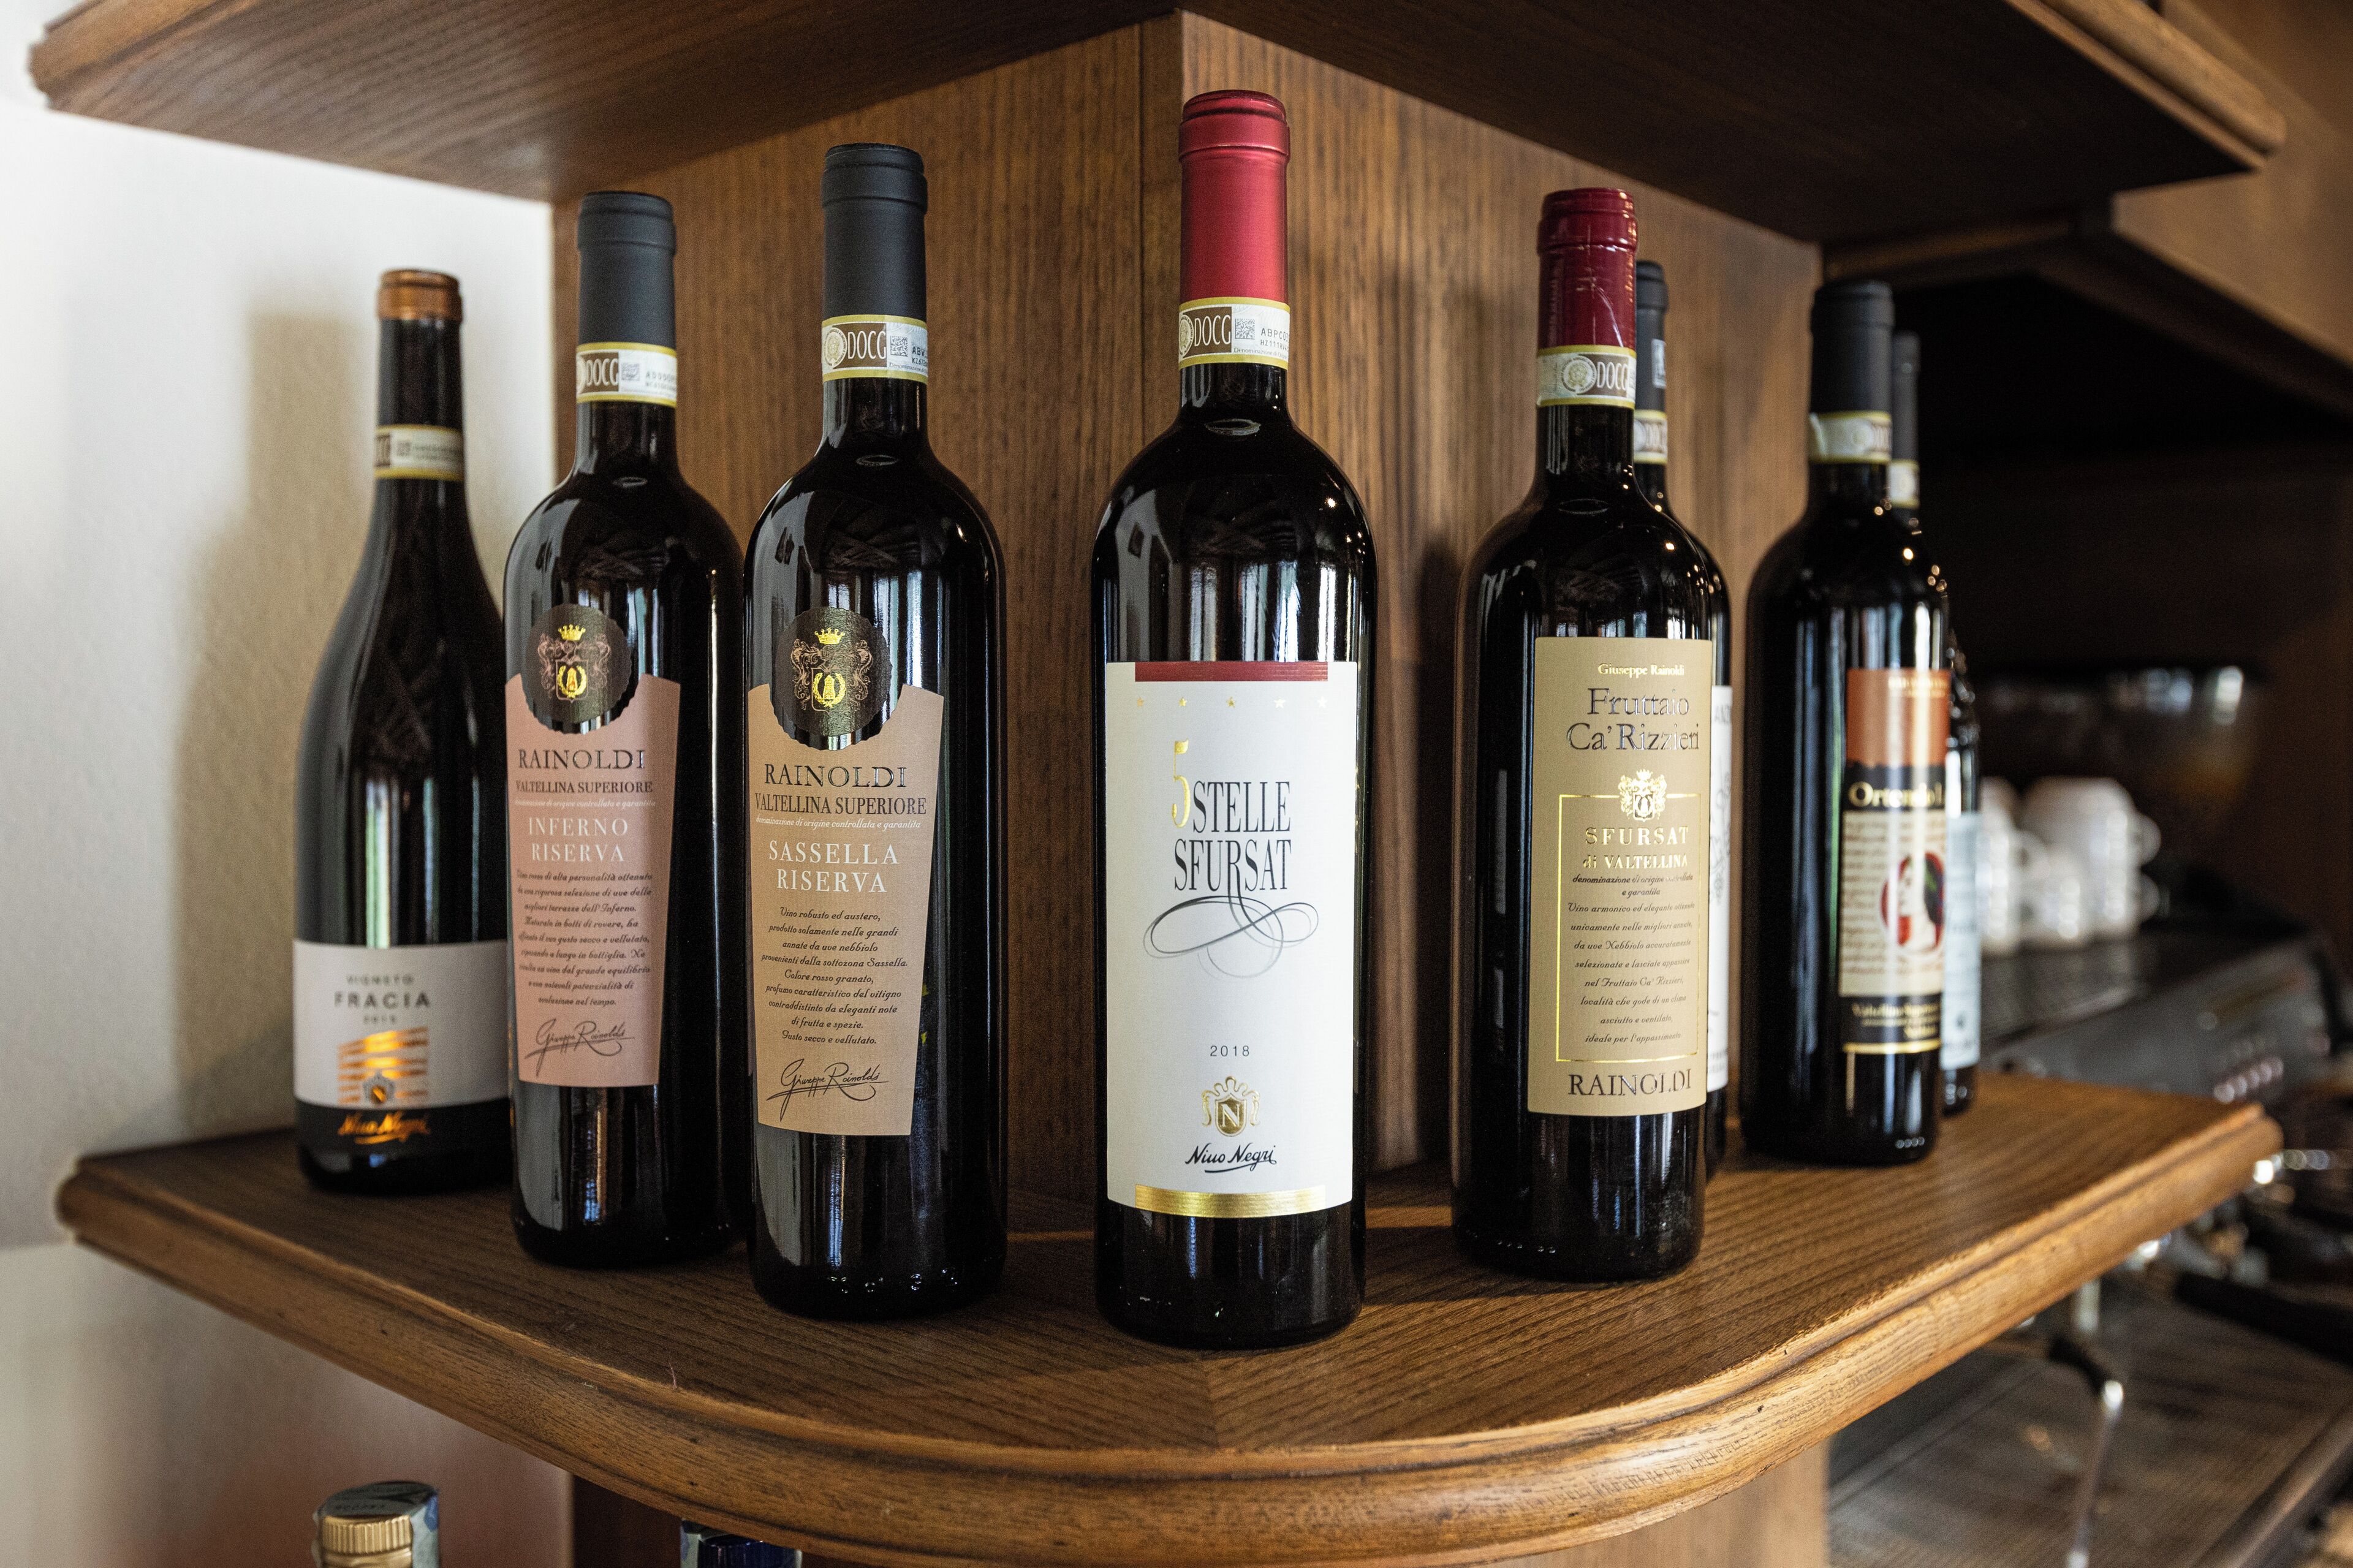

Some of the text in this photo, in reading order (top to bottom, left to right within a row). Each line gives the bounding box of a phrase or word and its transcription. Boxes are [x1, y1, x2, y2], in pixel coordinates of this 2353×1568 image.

[1194, 314, 1231, 347] DOCG
[847, 330, 887, 360] DOCG
[1598, 663, 1684, 678] Giuseppe Rainoldi
[1587, 687, 1689, 716] Fruttaio
[1616, 722, 1700, 751] Rizzieri
[518, 749, 646, 770] RAINOLDI
[764, 763, 907, 788] RAINOLDI
[516, 780, 654, 793] VALTELLINA SUPERIORE
[755, 792, 926, 815] VALTELLINA SUPERIORE
[529, 816, 629, 836] INFERNO
[795, 817, 803, 827] di
[804, 820, 830, 831] origine
[831, 818, 876, 829] controllata
[883, 820, 921, 832] garantita
[1585, 826, 1689, 846] SFURSAT
[532, 843, 625, 863] RISERVA
[768, 839, 900, 865] SASSELLA
[1173, 838, 1292, 892] SFURSAT
[1583, 854, 1688, 869] di VALTELLINA
[776, 868, 888, 893] RISERVA
[1572, 874, 1631, 884] denominazione
[1640, 876, 1664, 886] origine
[1627, 887, 1661, 899] garantita
[780, 906, 881, 922] Vino robusto ed austero,
[1568, 902, 1589, 912] Vino
[1632, 903, 1643, 912] ed
[1644, 903, 1673, 915] elegante
[768, 923, 899, 939] prodotto solamente nelle grandi
[1622, 921, 1642, 931] nelle
[1643, 921, 1672, 934] migliori
[782, 941, 808, 950] annate
[809, 941, 820, 951] da
[839, 942, 878, 952] nebbiolo
[1574, 940, 1585, 950] da
[1605, 940, 1644, 950] Nebbiolo
[761, 954, 908, 968] provenienti dalla sottozona Sassella.
[1575, 959, 1623, 969] selezionate
[1631, 959, 1661, 968] lasciate
[784, 969, 810, 980] Colore
[834, 974, 874, 985] granato,
[1585, 978, 1600, 987] nel
[1601, 977, 1637, 987] Fruttaio
[334, 990, 430, 1010] FRACIA
[765, 983, 901, 1001] profumo caratteristico del vitigno
[768, 1000, 898, 1017] contraddistinto da eleganti note
[1580, 996, 1614, 1006] località
[1615, 996, 1631, 1006] che
[1632, 996, 1651, 1009] gode
[1652, 995, 1660, 1004] di
[791, 1016, 798, 1025] di
[798, 1017, 824, 1029] frutta
[833, 1020, 863, 1031] spezie.
[782, 1029, 802, 1041] Gusto
[835, 1034, 877, 1044] vellutato.
[1585, 1033, 1629, 1045] ideale per
[1210, 1045, 1250, 1057] 2018
[1567, 1068, 1692, 1096] RAINOLDI
[1184, 1142, 1277, 1172] Nino Negri
